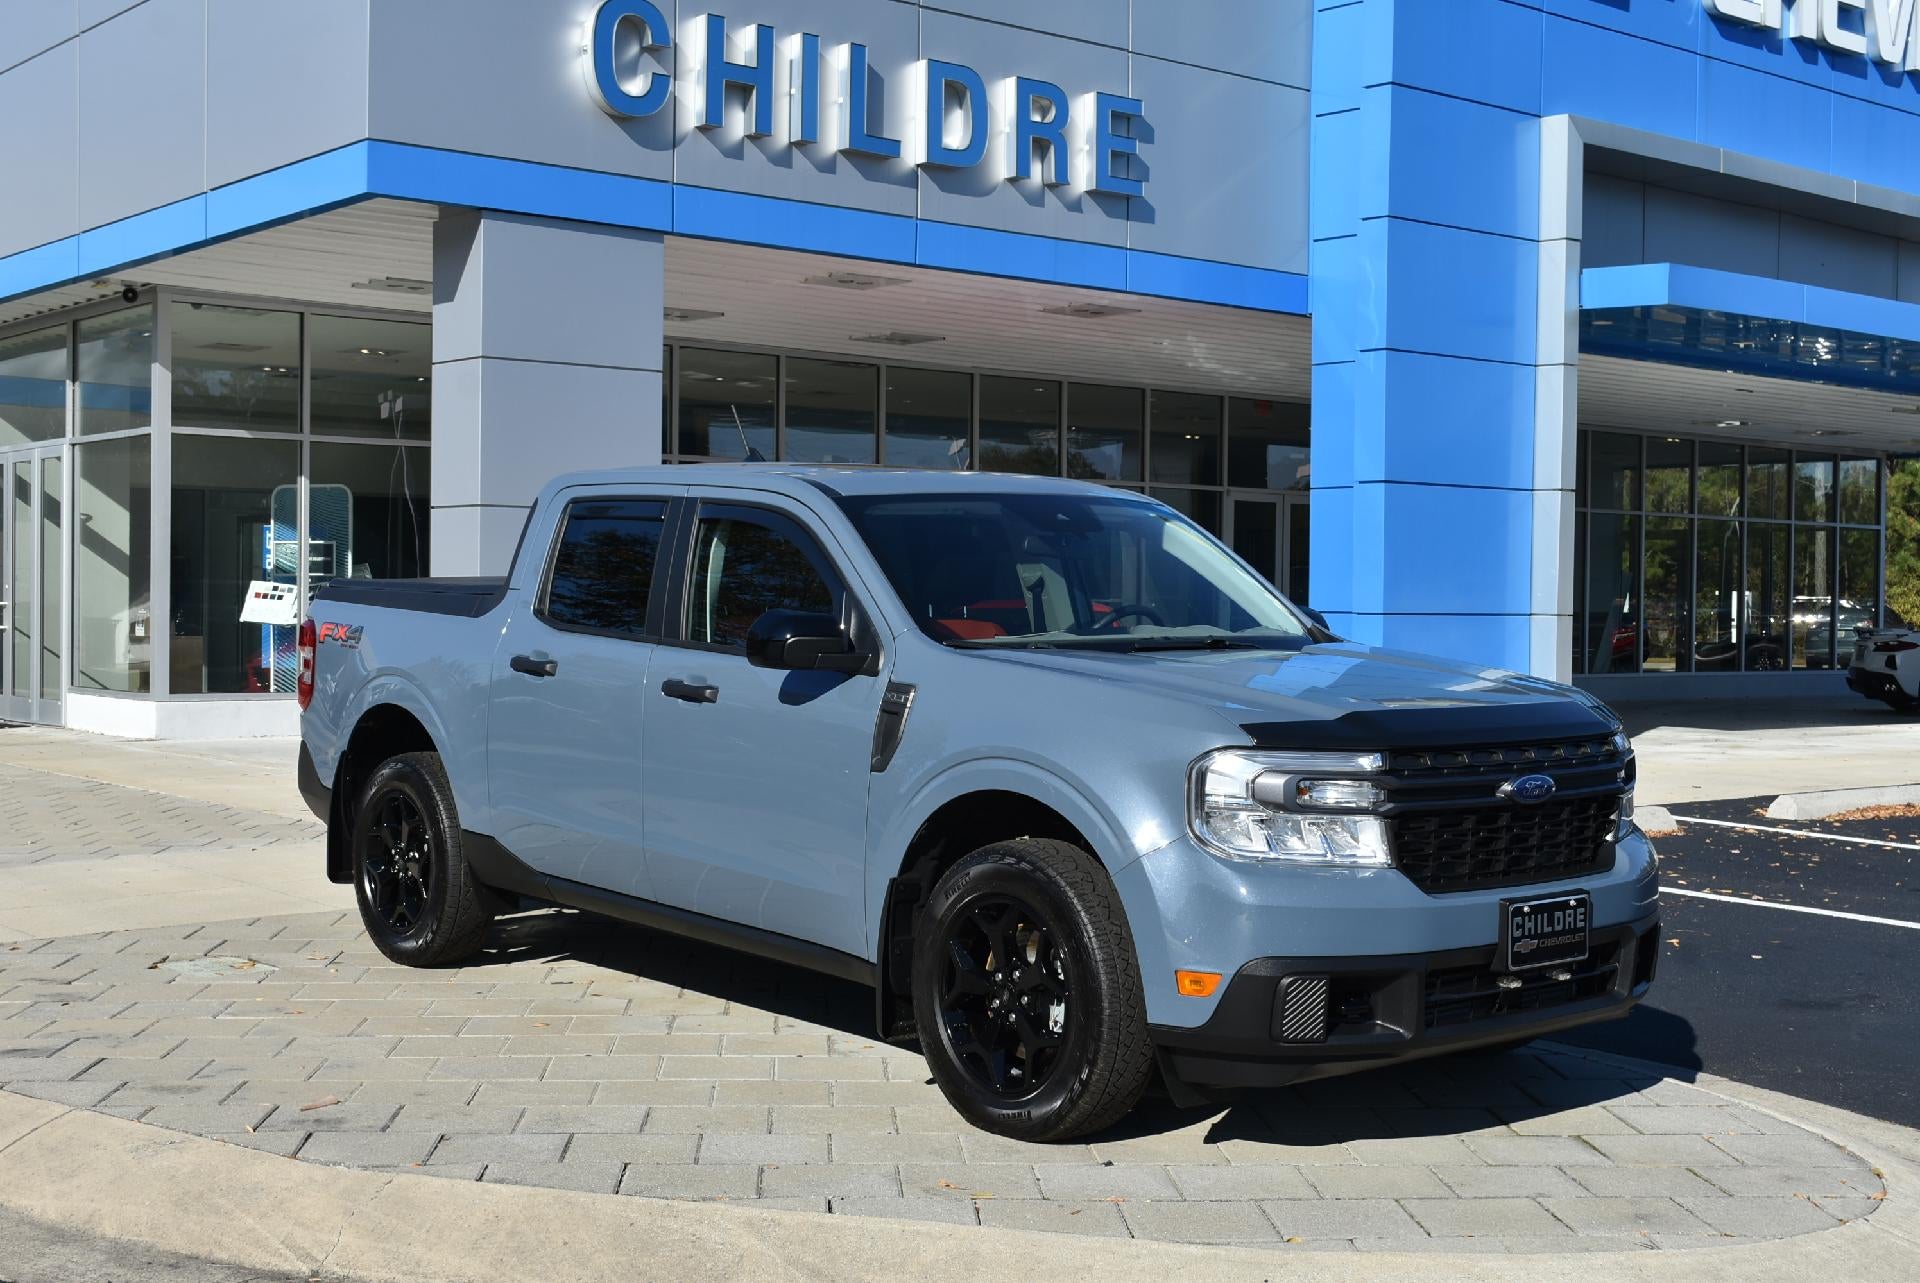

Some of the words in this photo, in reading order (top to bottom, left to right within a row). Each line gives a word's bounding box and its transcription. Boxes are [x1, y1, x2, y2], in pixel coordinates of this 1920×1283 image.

[588, 0, 1144, 198] CHILDRE
[319, 621, 364, 645] FX4
[1512, 907, 1585, 938] CHILDRE
[1539, 932, 1585, 948] CHEVROLET
